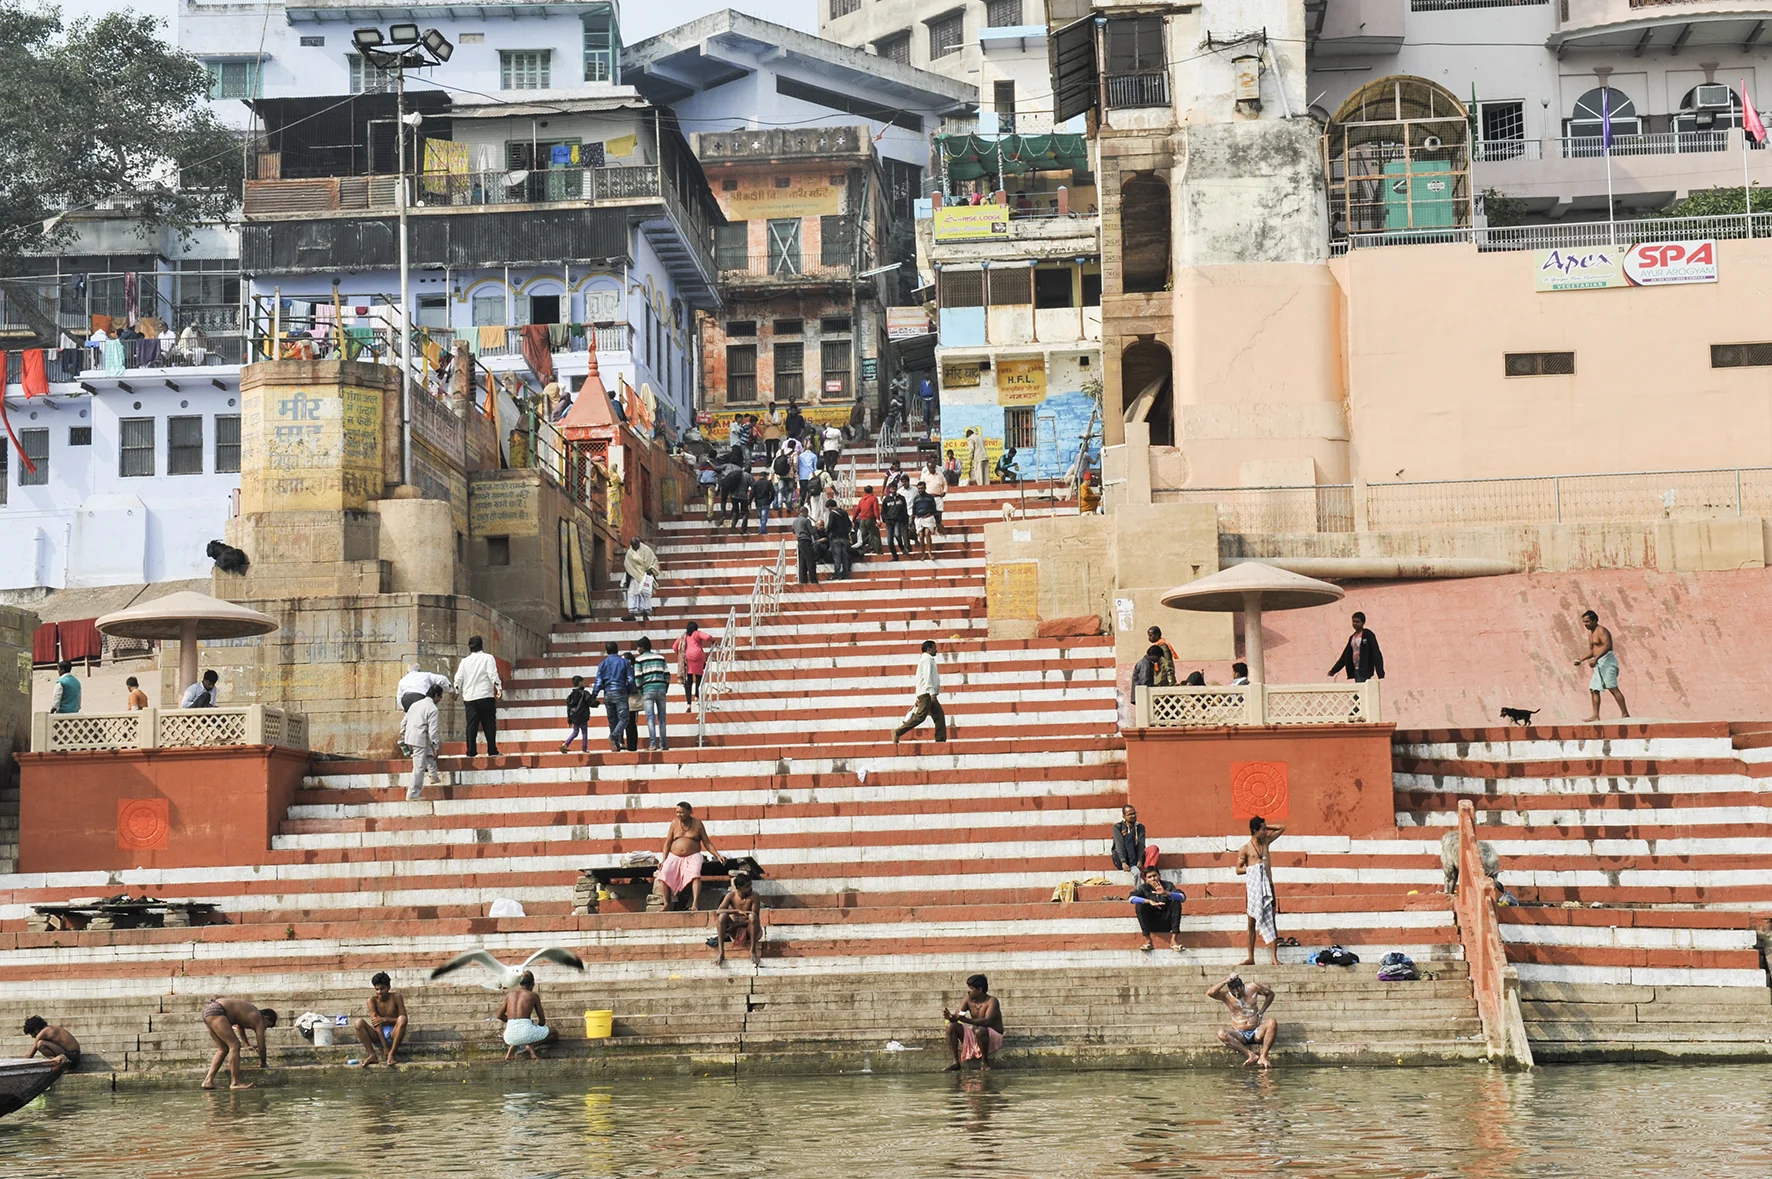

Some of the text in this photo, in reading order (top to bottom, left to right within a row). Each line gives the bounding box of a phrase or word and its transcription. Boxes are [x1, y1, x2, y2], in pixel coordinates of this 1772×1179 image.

[1543, 250, 1615, 275] Apex
[1638, 243, 1713, 268] SPA
[1640, 266, 1715, 277] AYUR AROGYAM
[1556, 282, 1603, 290] VEGETARIAN
[945, 366, 979, 380] मीर घाट
[346, 390, 378, 404] गंगा जल
[278, 391, 324, 421] मीर
[275, 425, 324, 444] घाट
